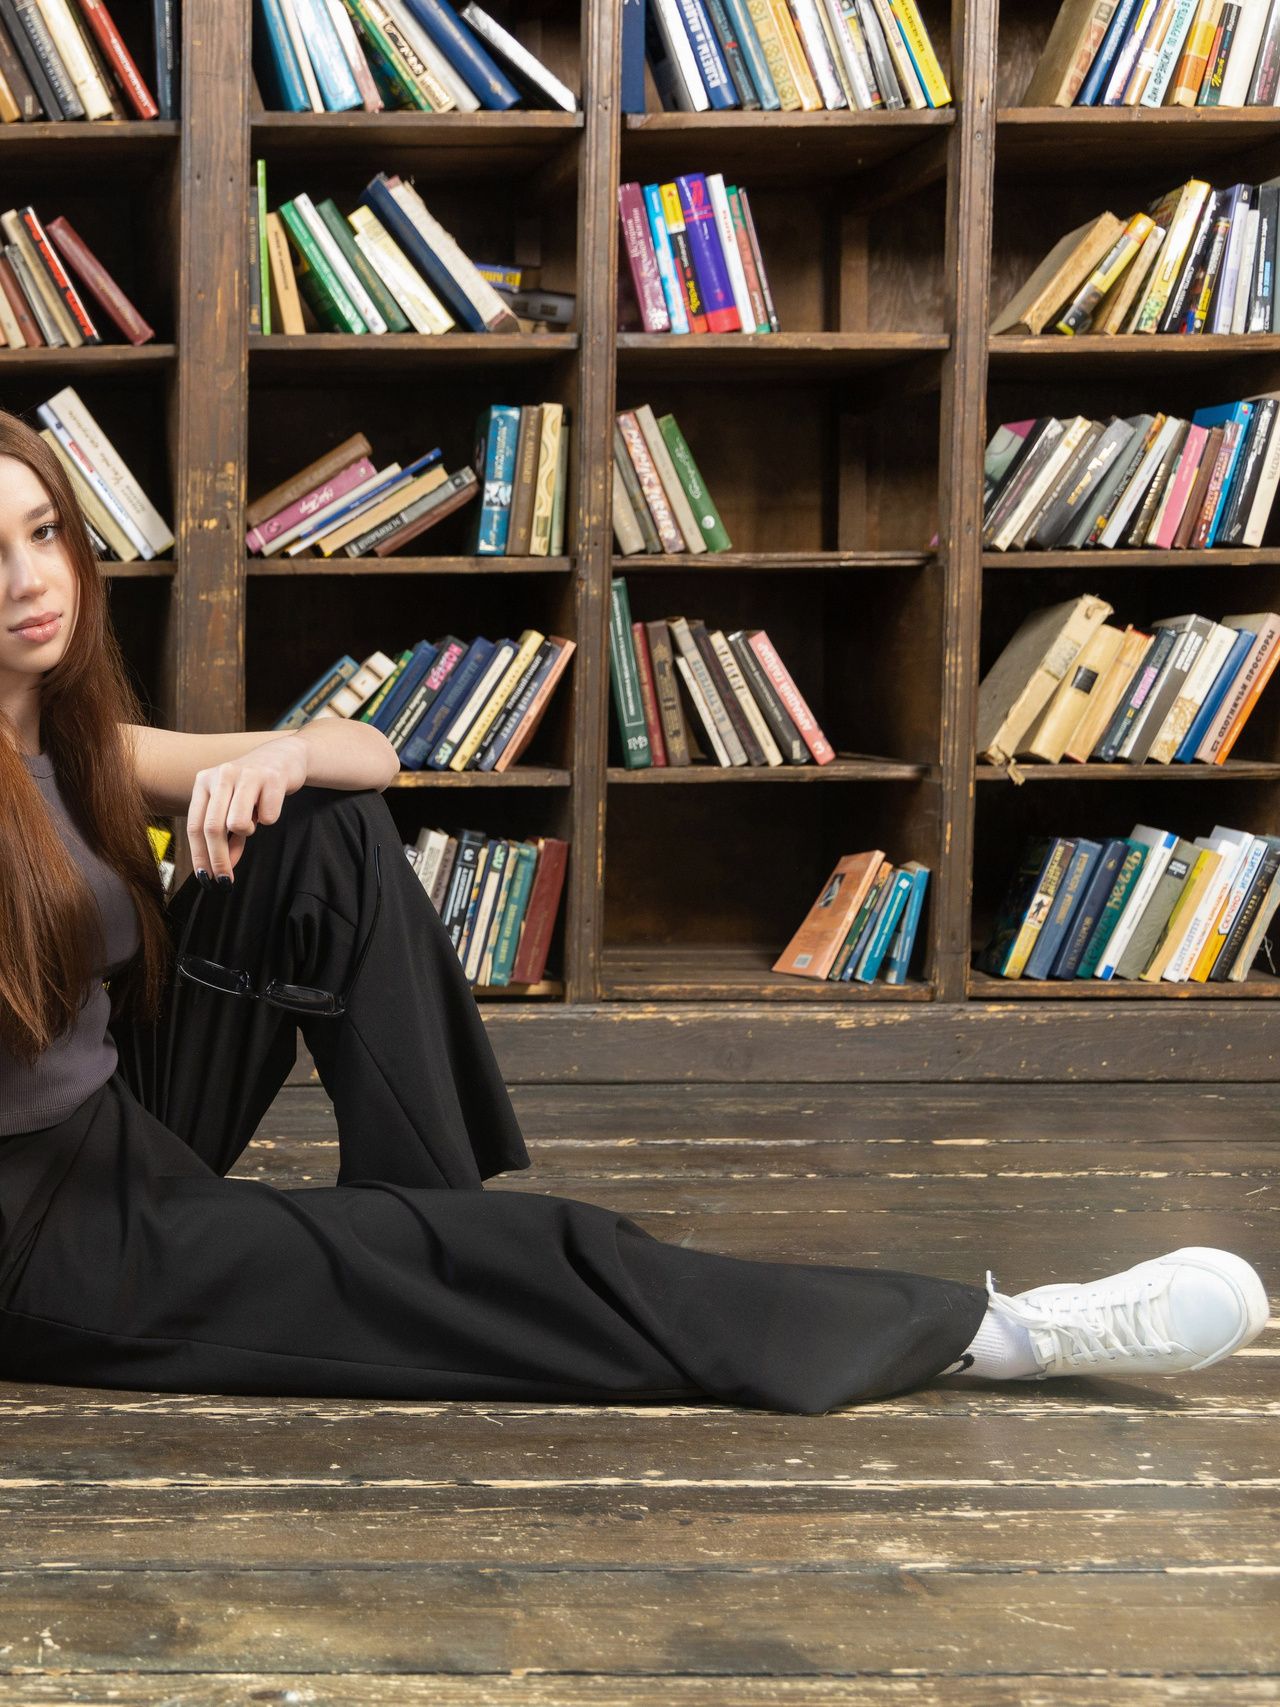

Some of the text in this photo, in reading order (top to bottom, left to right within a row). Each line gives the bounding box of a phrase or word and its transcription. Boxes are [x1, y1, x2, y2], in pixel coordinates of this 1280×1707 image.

[696, 42, 721, 89] ВЗЛЕТЫ
[1152, 47, 1173, 85] ФРЭНСИС
[1169, 7, 1188, 36] РУКОЯТЬ
[690, 658, 718, 706] ТУРГЕНЕВ
[755, 638, 813, 732] АРКАДИЙ ГАЙДАР
[1217, 628, 1275, 738] ОХОТНИЧЬИ ПРОСТОРЫ
[1220, 845, 1263, 931] СКУЧНО? ИГРАЙТЕ!
